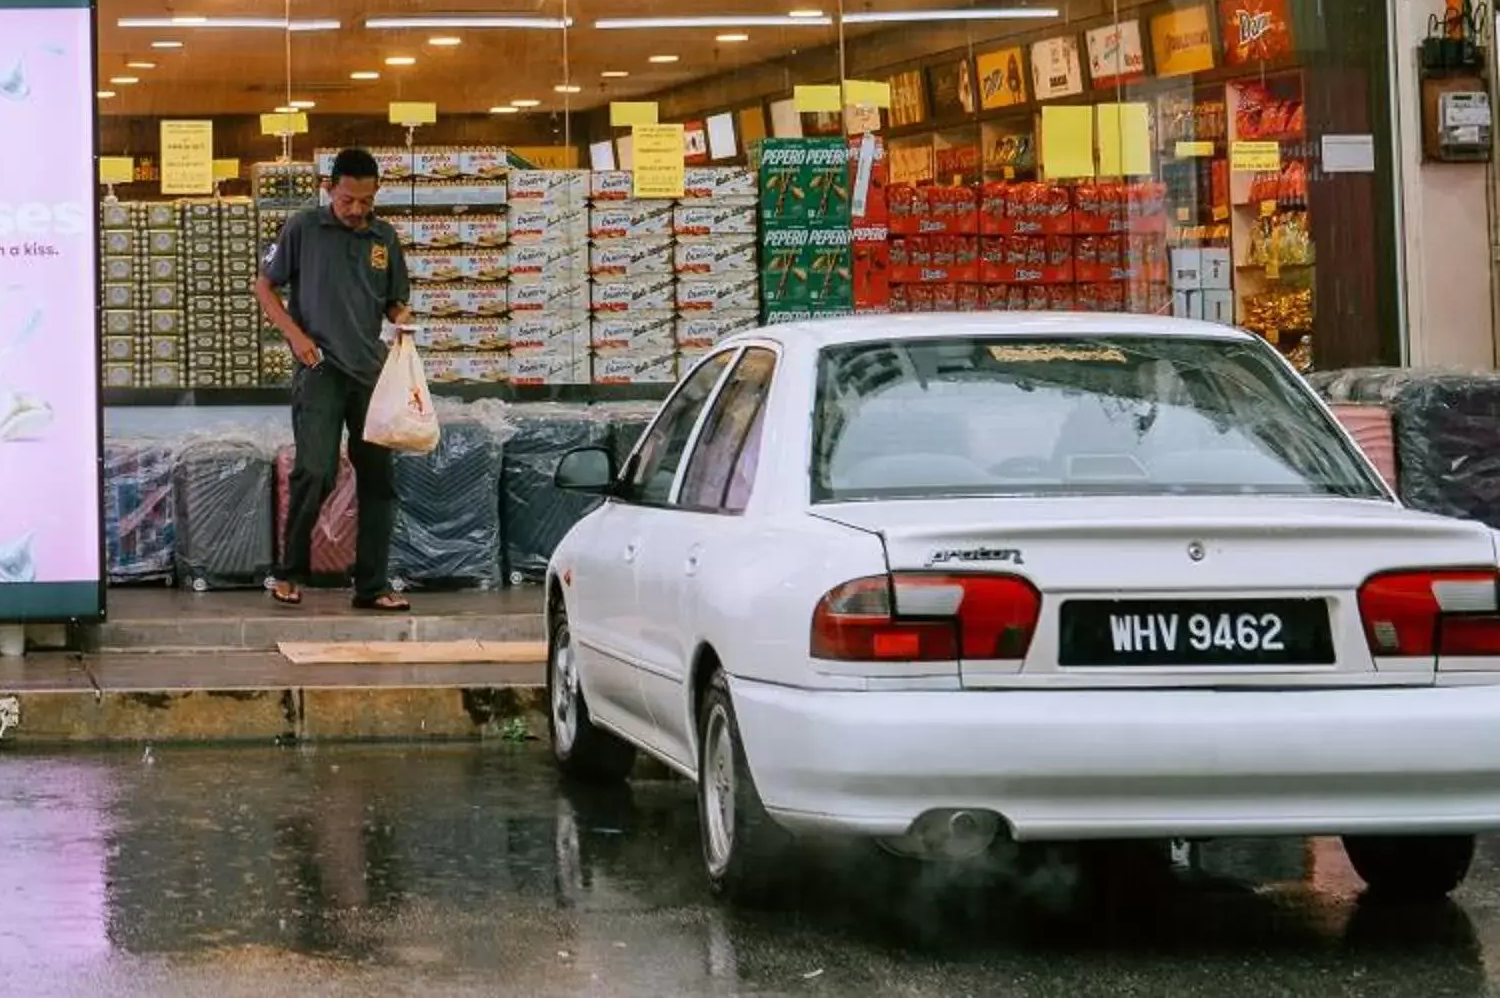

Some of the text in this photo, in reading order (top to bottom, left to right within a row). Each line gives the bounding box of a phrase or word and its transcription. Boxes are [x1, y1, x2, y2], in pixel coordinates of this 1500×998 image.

[9, 246, 20, 257] a
[23, 242, 59, 257] kiss.
[1108, 612, 1286, 653] WHV 9462
